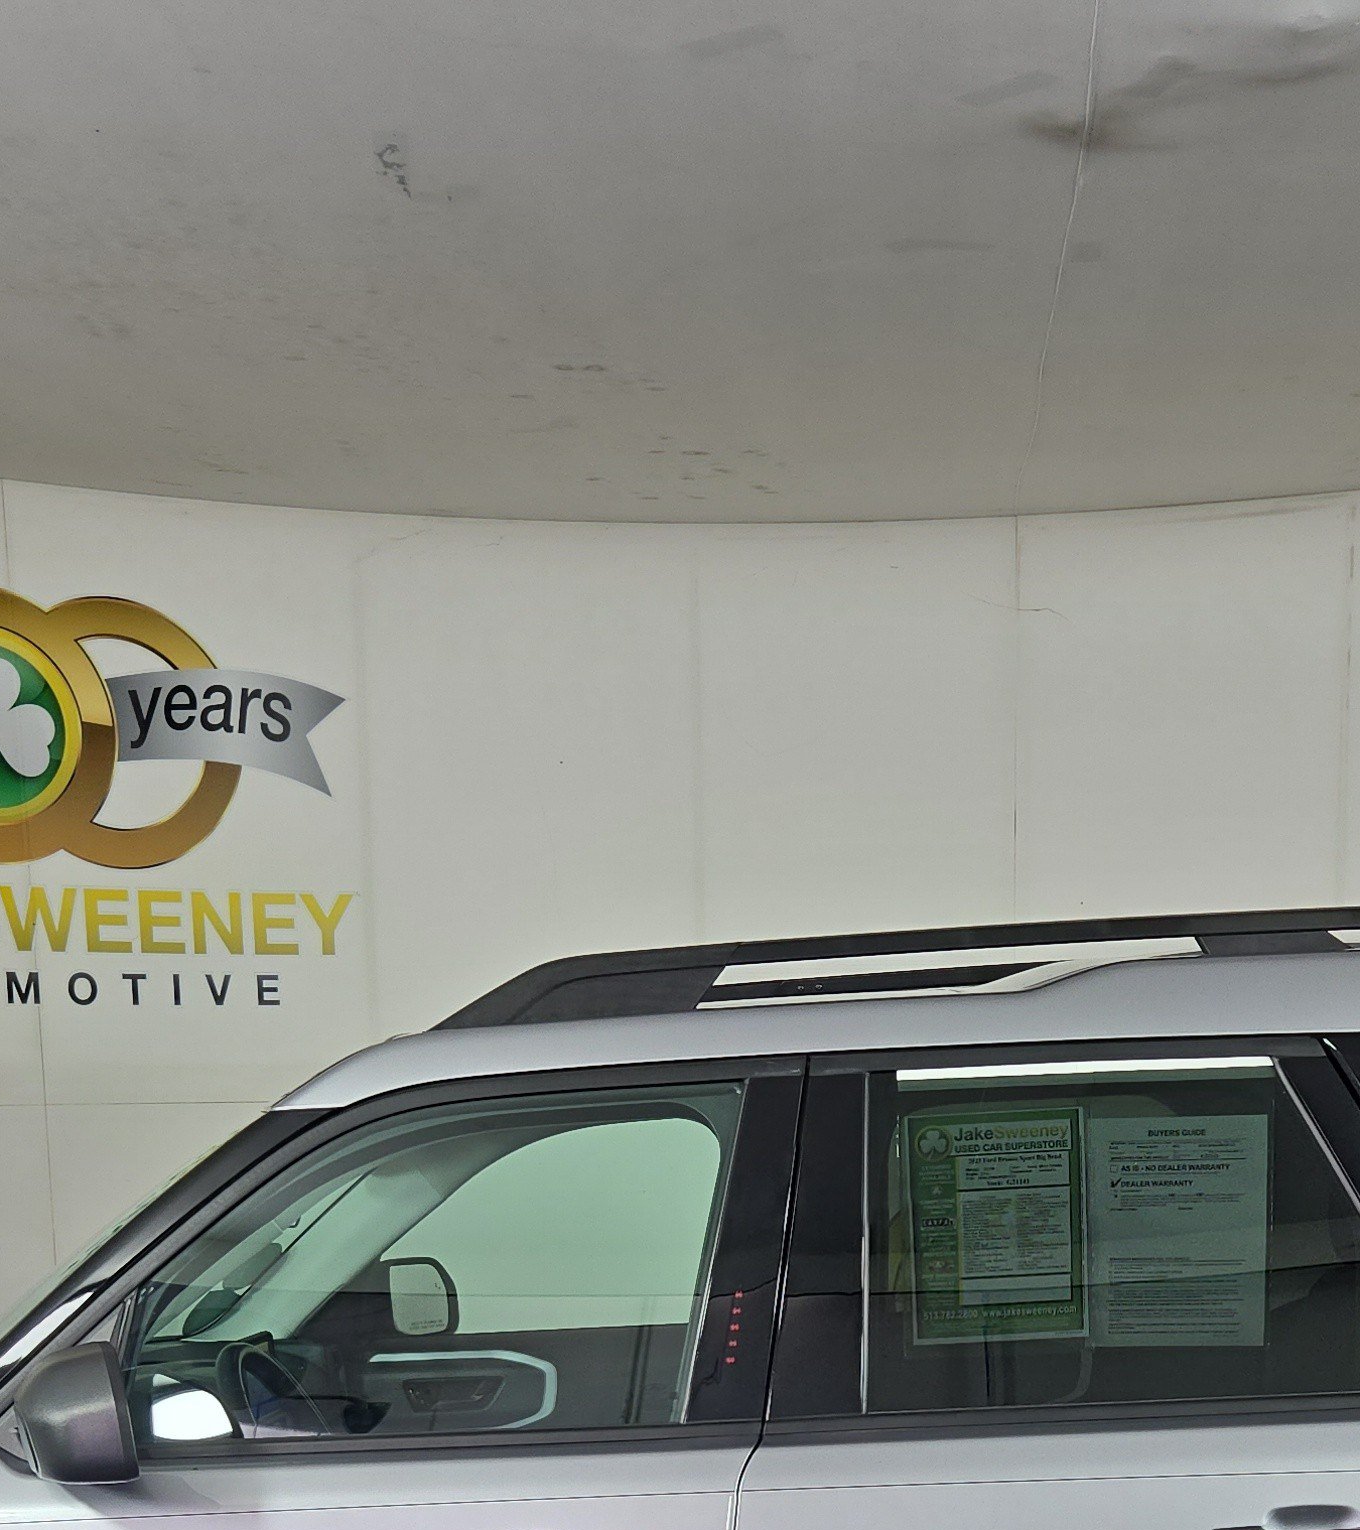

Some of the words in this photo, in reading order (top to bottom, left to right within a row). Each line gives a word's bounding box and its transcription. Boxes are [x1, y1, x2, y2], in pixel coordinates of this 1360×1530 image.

[128, 683, 293, 748] years
[954, 1144, 981, 1153] USED
[982, 1142, 1003, 1152] CAR
[1004, 1139, 1069, 1151] SUPERSTORE
[1158, 1164, 1187, 1172] DEALER
[1189, 1163, 1231, 1171] WARRANTY
[1120, 1180, 1150, 1188] DEALER
[1151, 1179, 1193, 1187] WARRANTY
